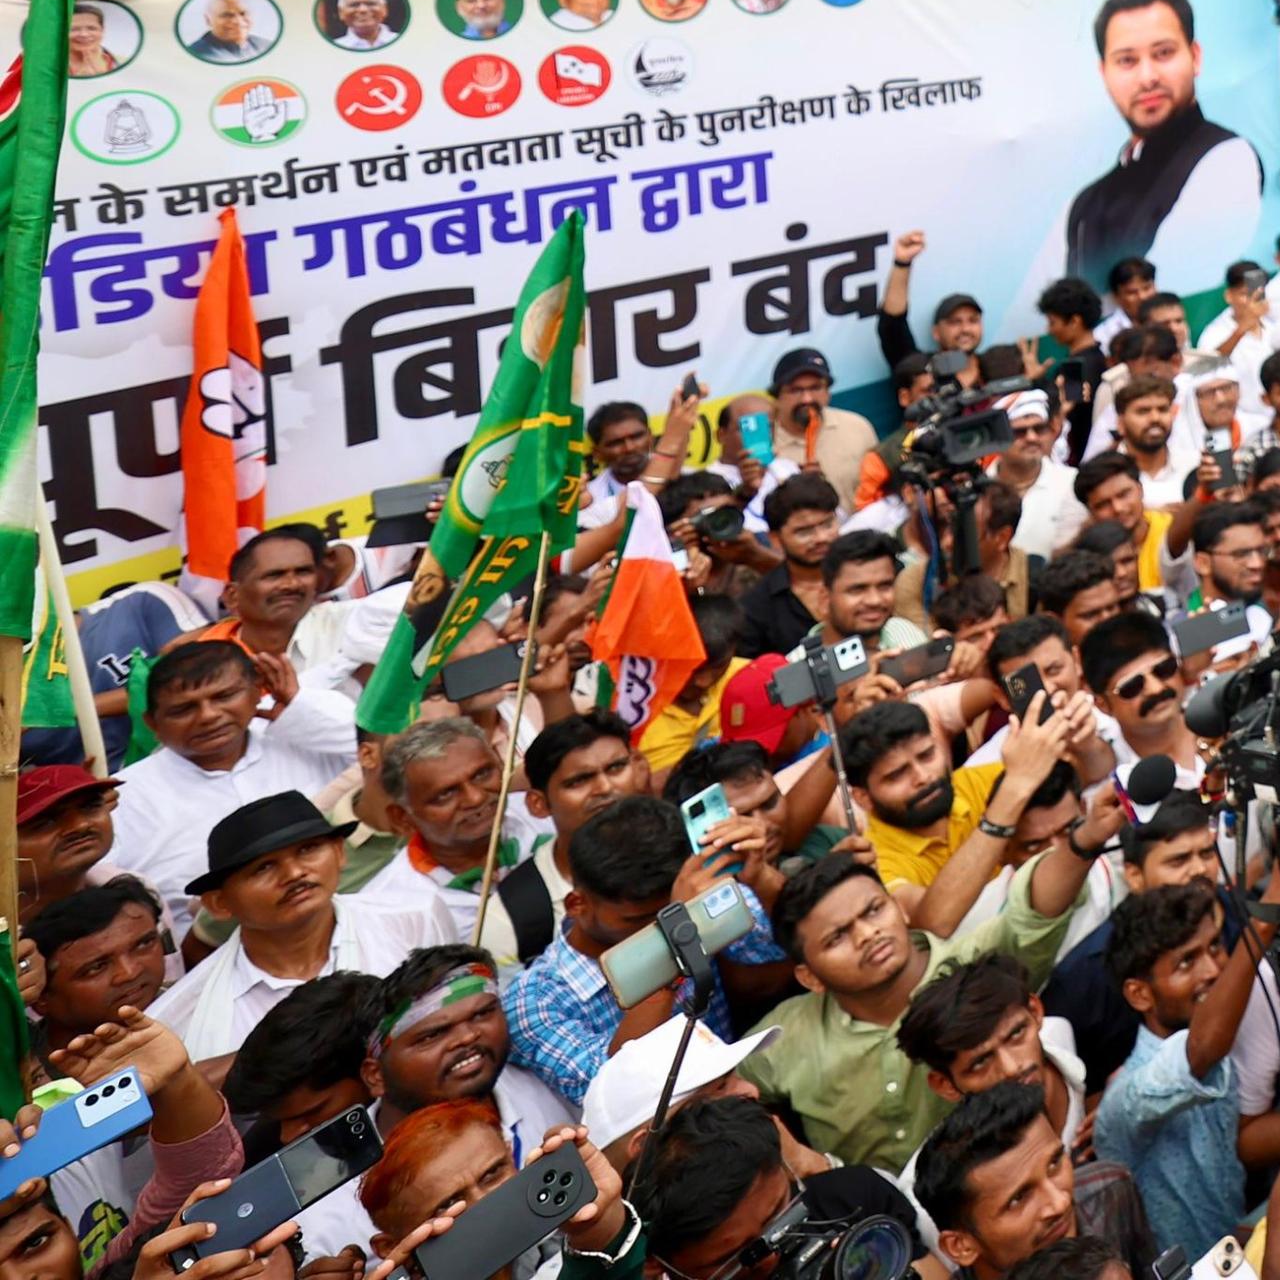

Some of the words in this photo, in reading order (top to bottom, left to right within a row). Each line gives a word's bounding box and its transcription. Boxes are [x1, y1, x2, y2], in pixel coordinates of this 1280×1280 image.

[40, 231, 278, 333] डिया
[293, 179, 618, 279] गठबंधन
[630, 150, 774, 234] द्वारा
[90, 182, 148, 226] के
[157, 157, 341, 218] समर्थन
[349, 144, 410, 188] एवं
[417, 131, 564, 176] मतदाता
[571, 111, 646, 164] सूची
[652, 108, 686, 144] के
[694, 95, 837, 146] पुनरीक्षण
[843, 83, 873, 117] के
[879, 75, 984, 115] खिलाफ
[319, 266, 711, 448] बिार
[730, 221, 889, 337] बंद
